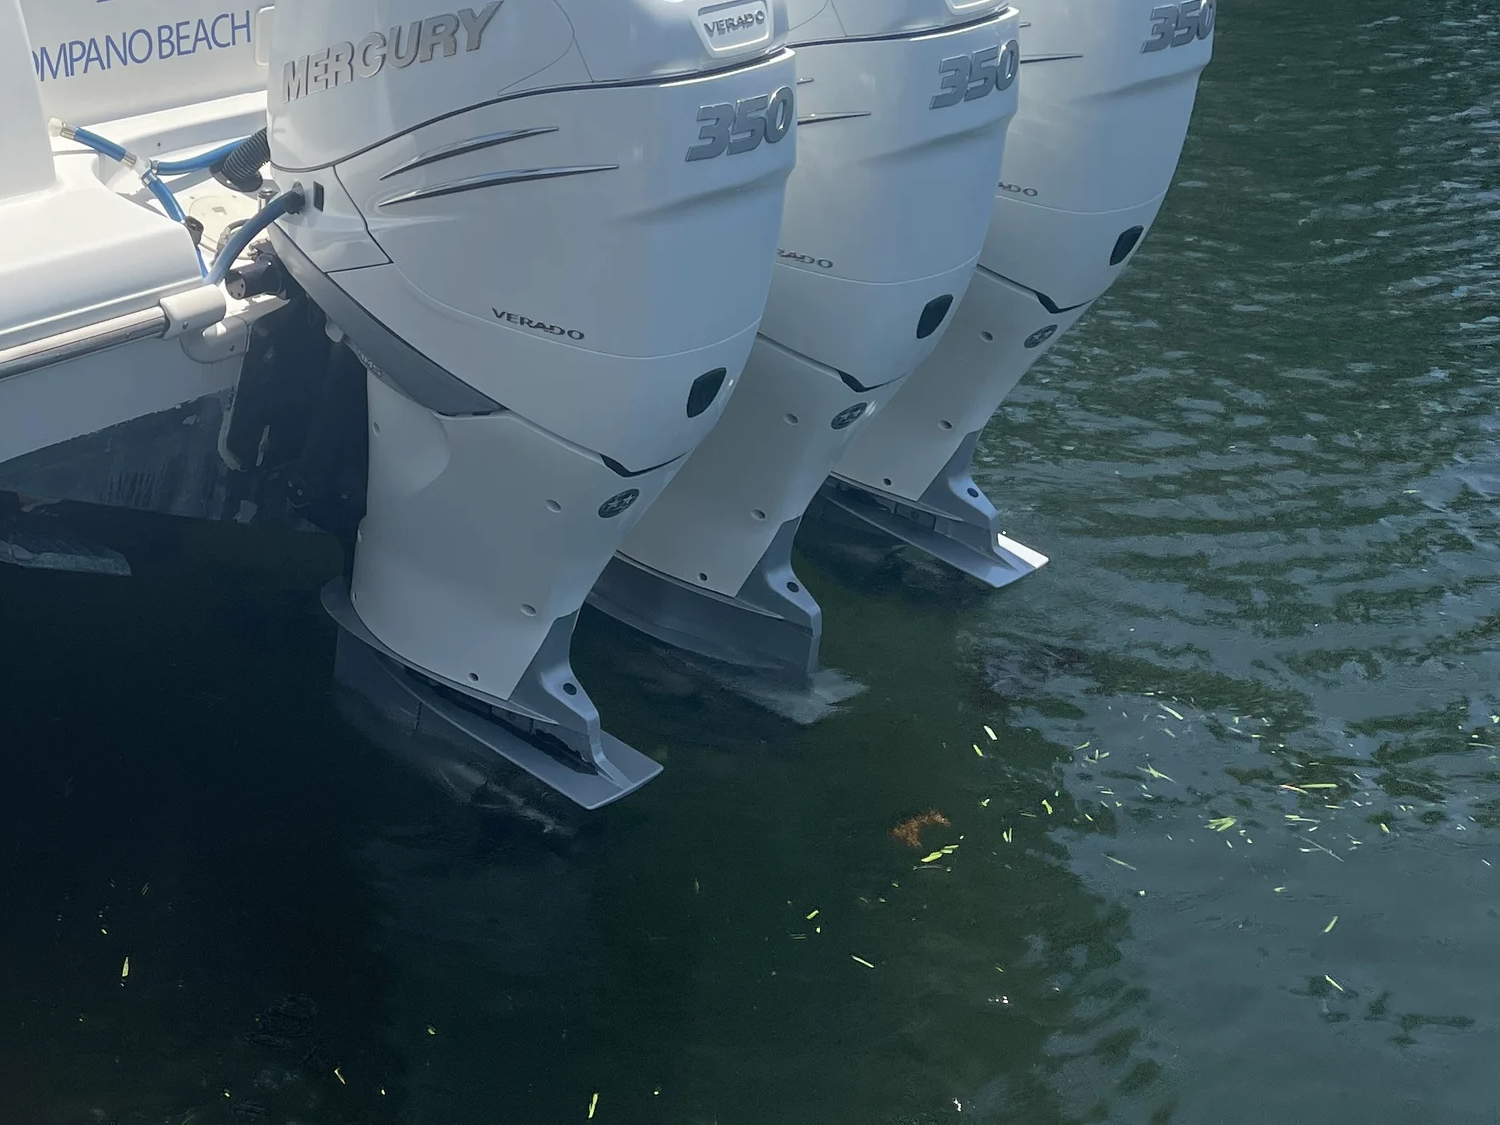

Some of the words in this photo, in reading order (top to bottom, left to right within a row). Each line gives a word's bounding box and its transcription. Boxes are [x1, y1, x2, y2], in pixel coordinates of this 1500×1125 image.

[157, 10, 251, 60] BEACH
[282, 0, 505, 104] MERCURY
[703, 9, 766, 37] VERADO
[929, 39, 1019, 110] 350
[685, 85, 794, 162] 350
[491, 307, 585, 340] VERADO
